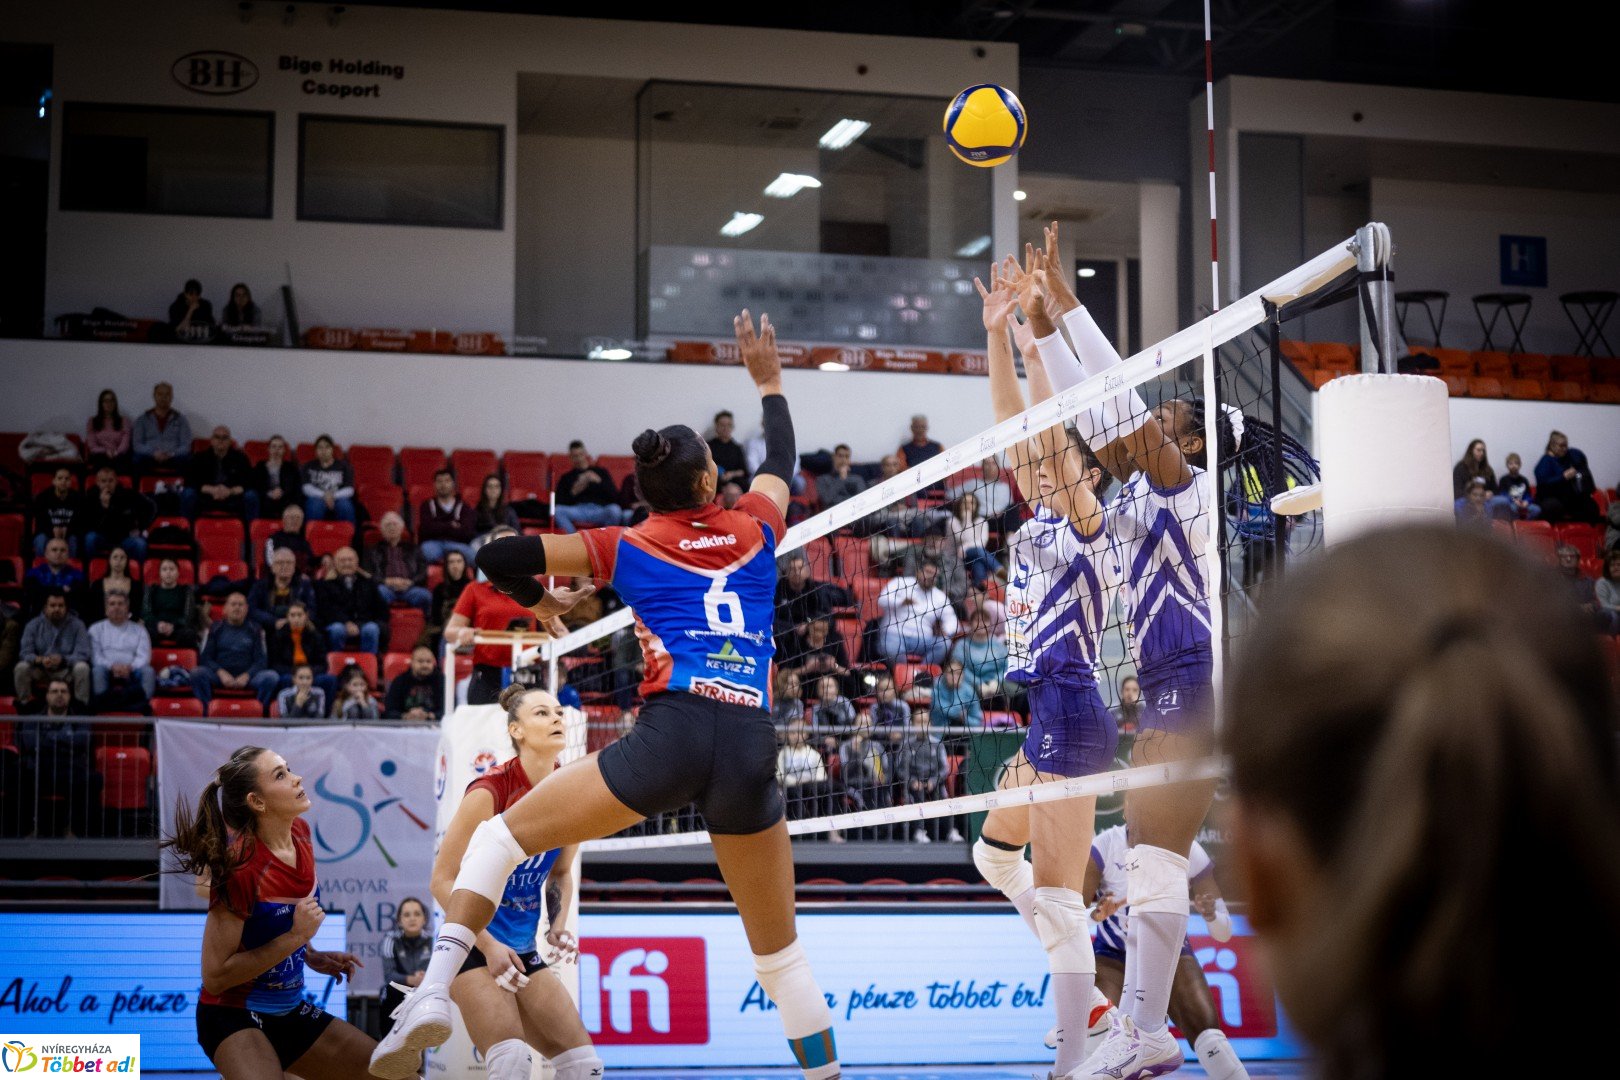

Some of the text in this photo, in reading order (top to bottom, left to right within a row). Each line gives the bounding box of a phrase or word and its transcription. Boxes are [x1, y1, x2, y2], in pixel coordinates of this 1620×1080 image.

[189, 58, 242, 88] BH
[279, 55, 404, 80] Bige Holding
[302, 79, 380, 99] Csoport
[678, 533, 738, 551] Calkins
[703, 576, 745, 633] 6
[705, 659, 742, 674] KE-VIZ
[693, 684, 757, 709] STRABAG
[319, 878, 388, 893] MAGYAR
[0, 974, 74, 1014] Ahol
[79, 992, 100, 1013] a
[105, 984, 190, 1025] pénze
[846, 983, 918, 1020] pénze
[1012, 973, 1050, 1008] ér!
